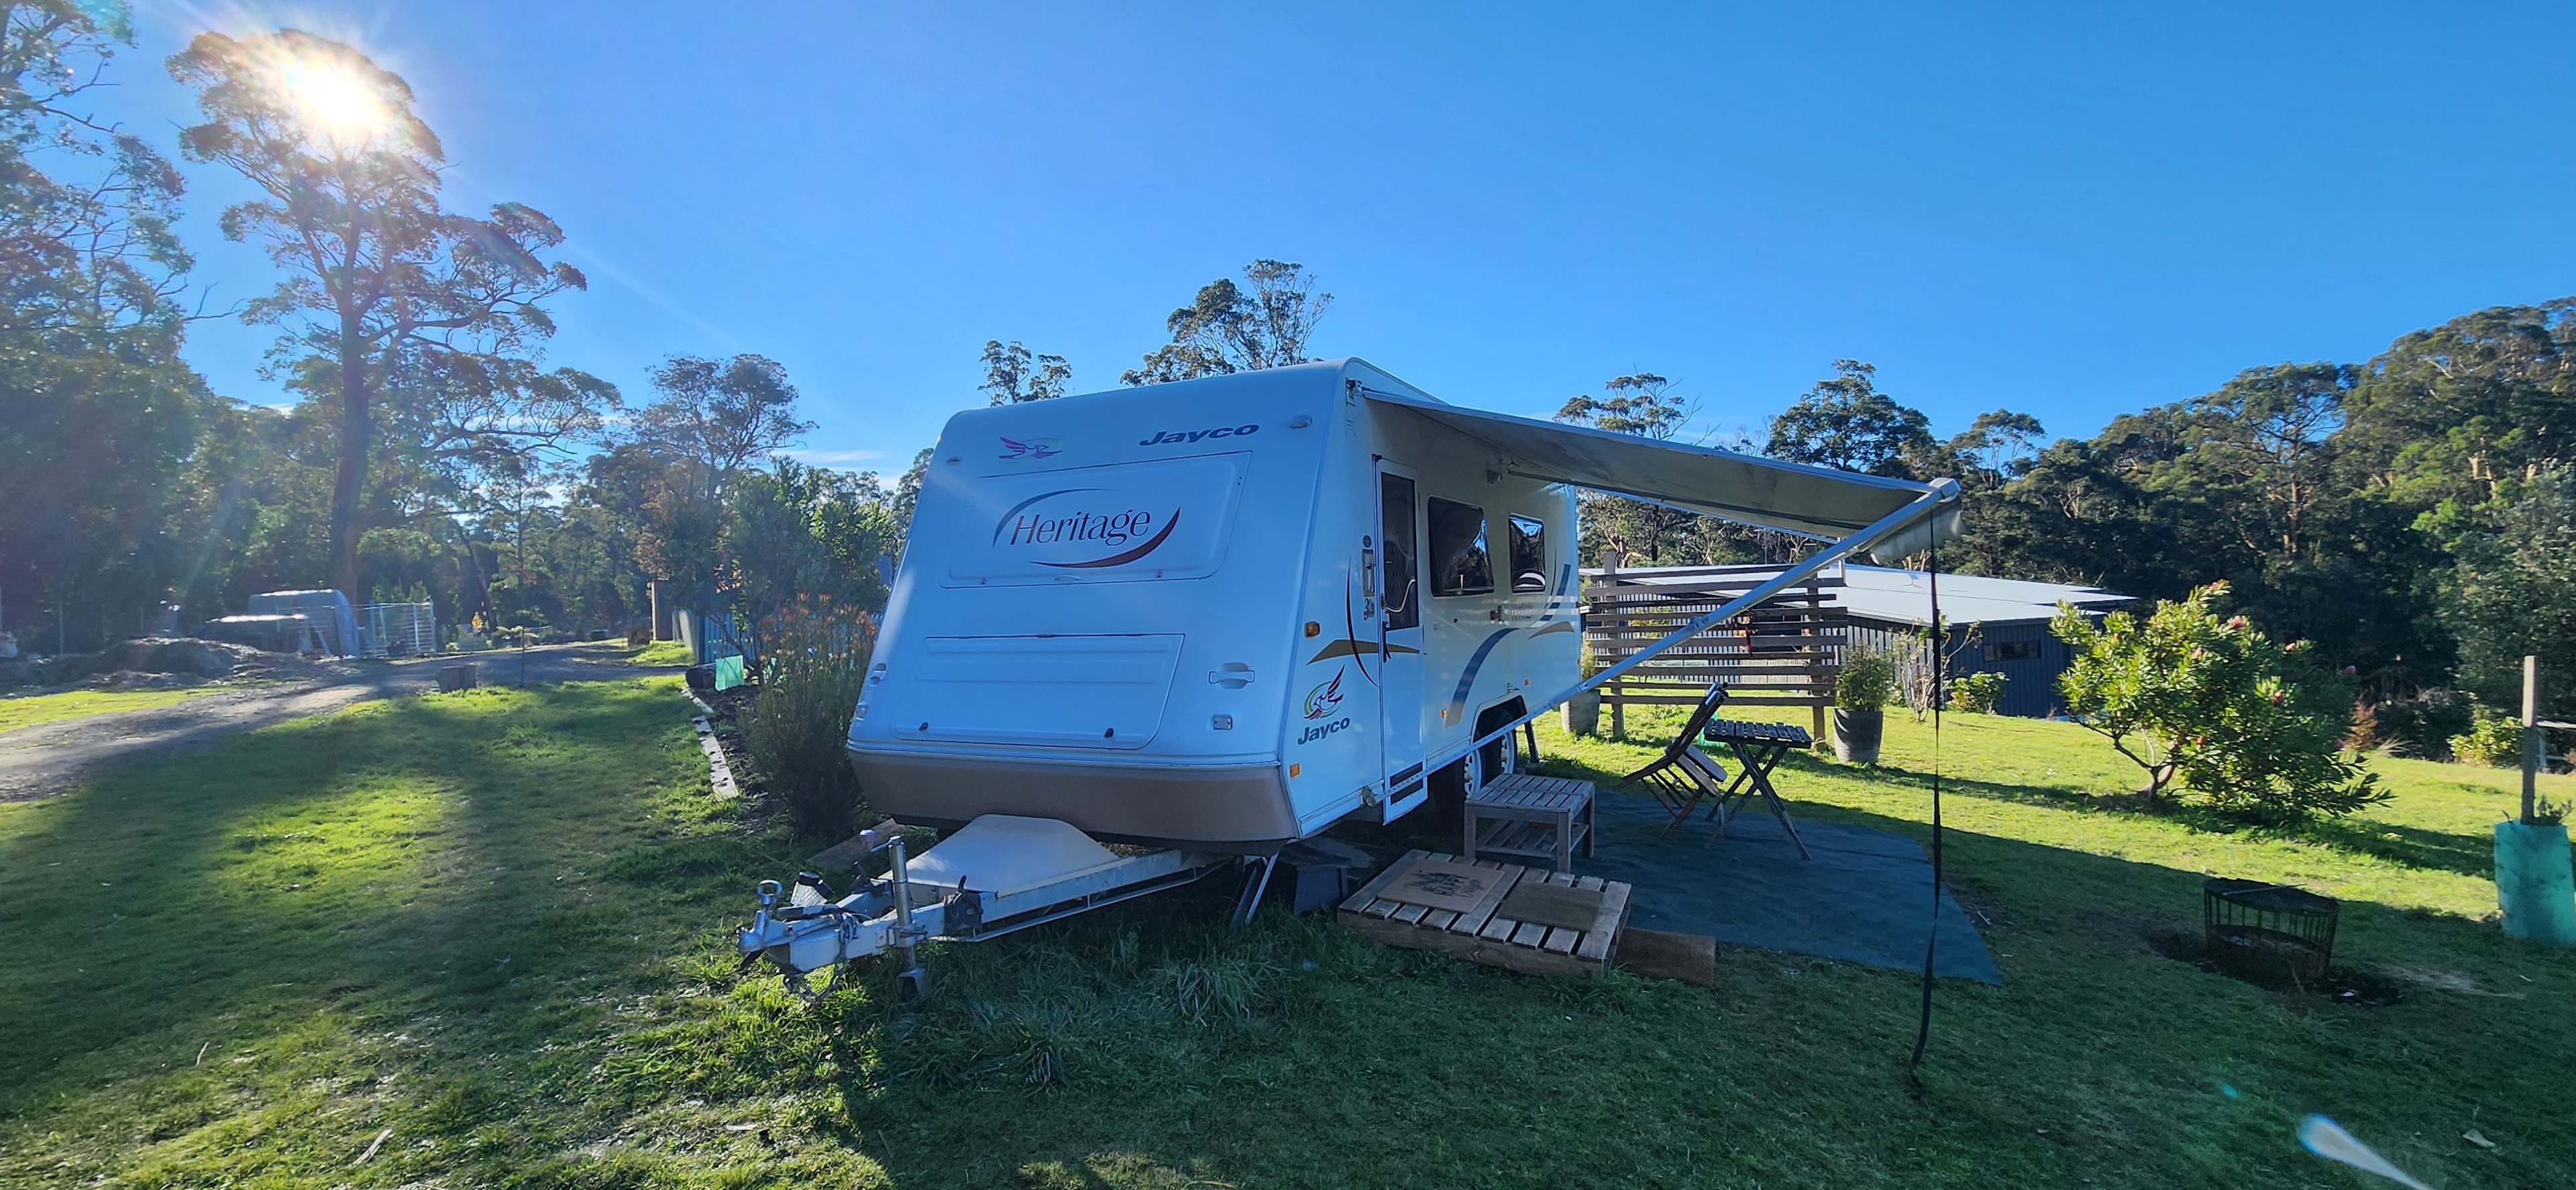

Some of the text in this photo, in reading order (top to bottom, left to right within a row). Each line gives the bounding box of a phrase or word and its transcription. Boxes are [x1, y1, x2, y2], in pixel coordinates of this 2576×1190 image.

[1139, 425, 1260, 445] Jayco
[1010, 508, 1150, 546] Heritage
[1297, 717, 1350, 745] Jayco
